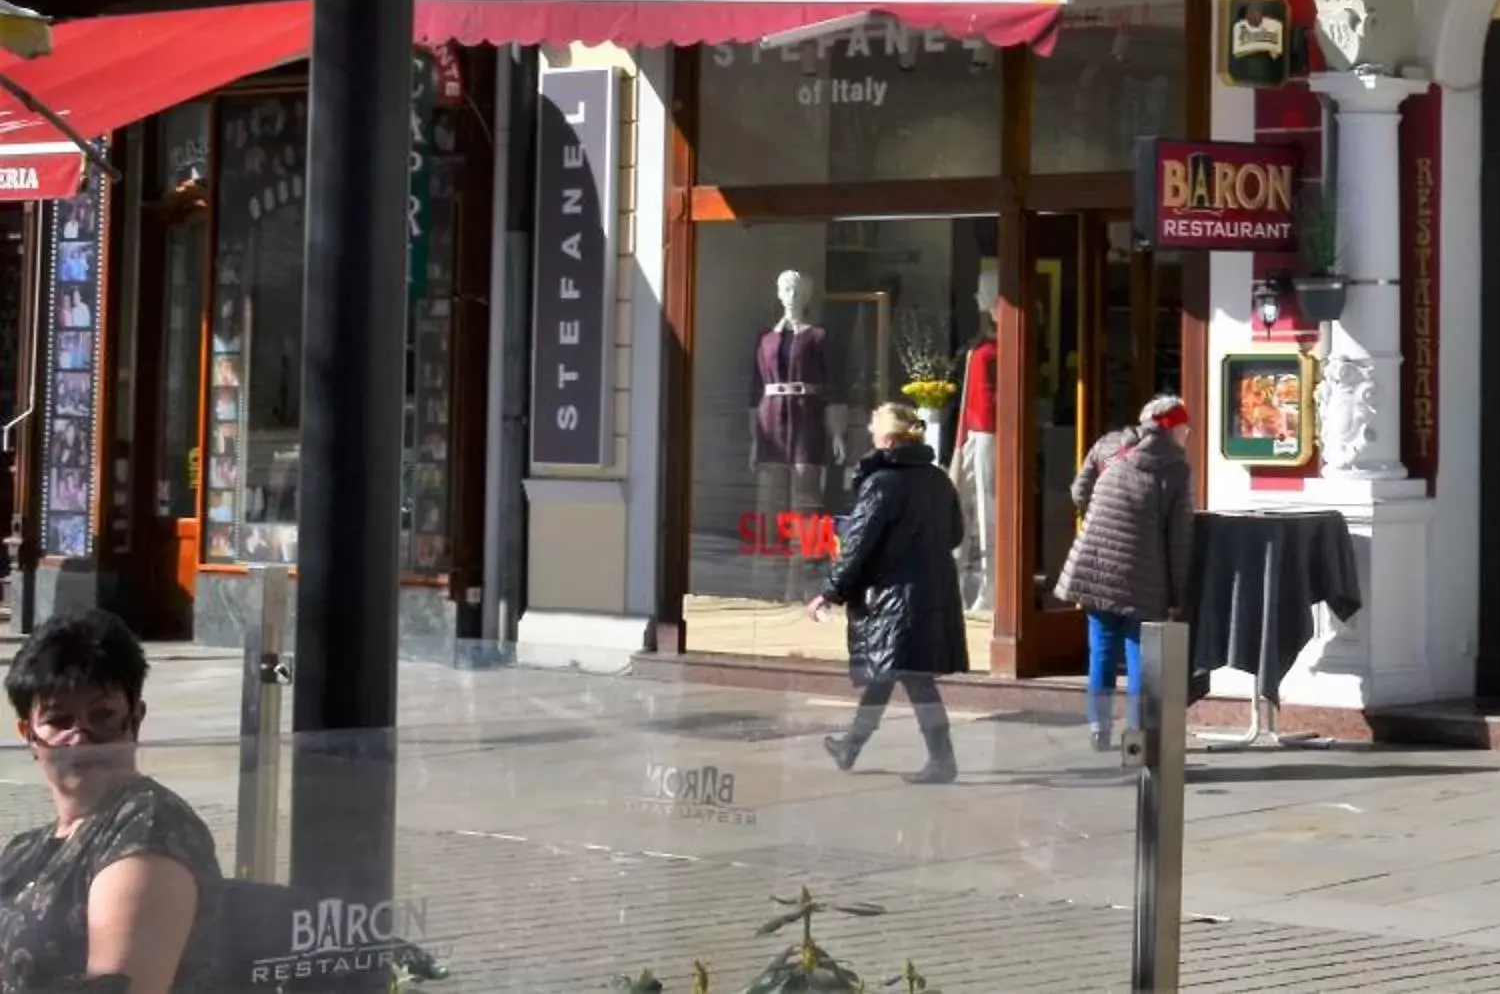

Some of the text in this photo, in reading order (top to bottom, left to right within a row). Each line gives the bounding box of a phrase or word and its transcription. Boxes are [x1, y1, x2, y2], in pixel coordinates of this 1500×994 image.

[798, 75, 888, 108] of Italy
[1162, 151, 1292, 212] BARON
[1163, 218, 1292, 239] RESTAURANT
[556, 100, 585, 431] STEFANEL
[737, 510, 837, 559] SLEVA
[291, 897, 429, 951] BARON
